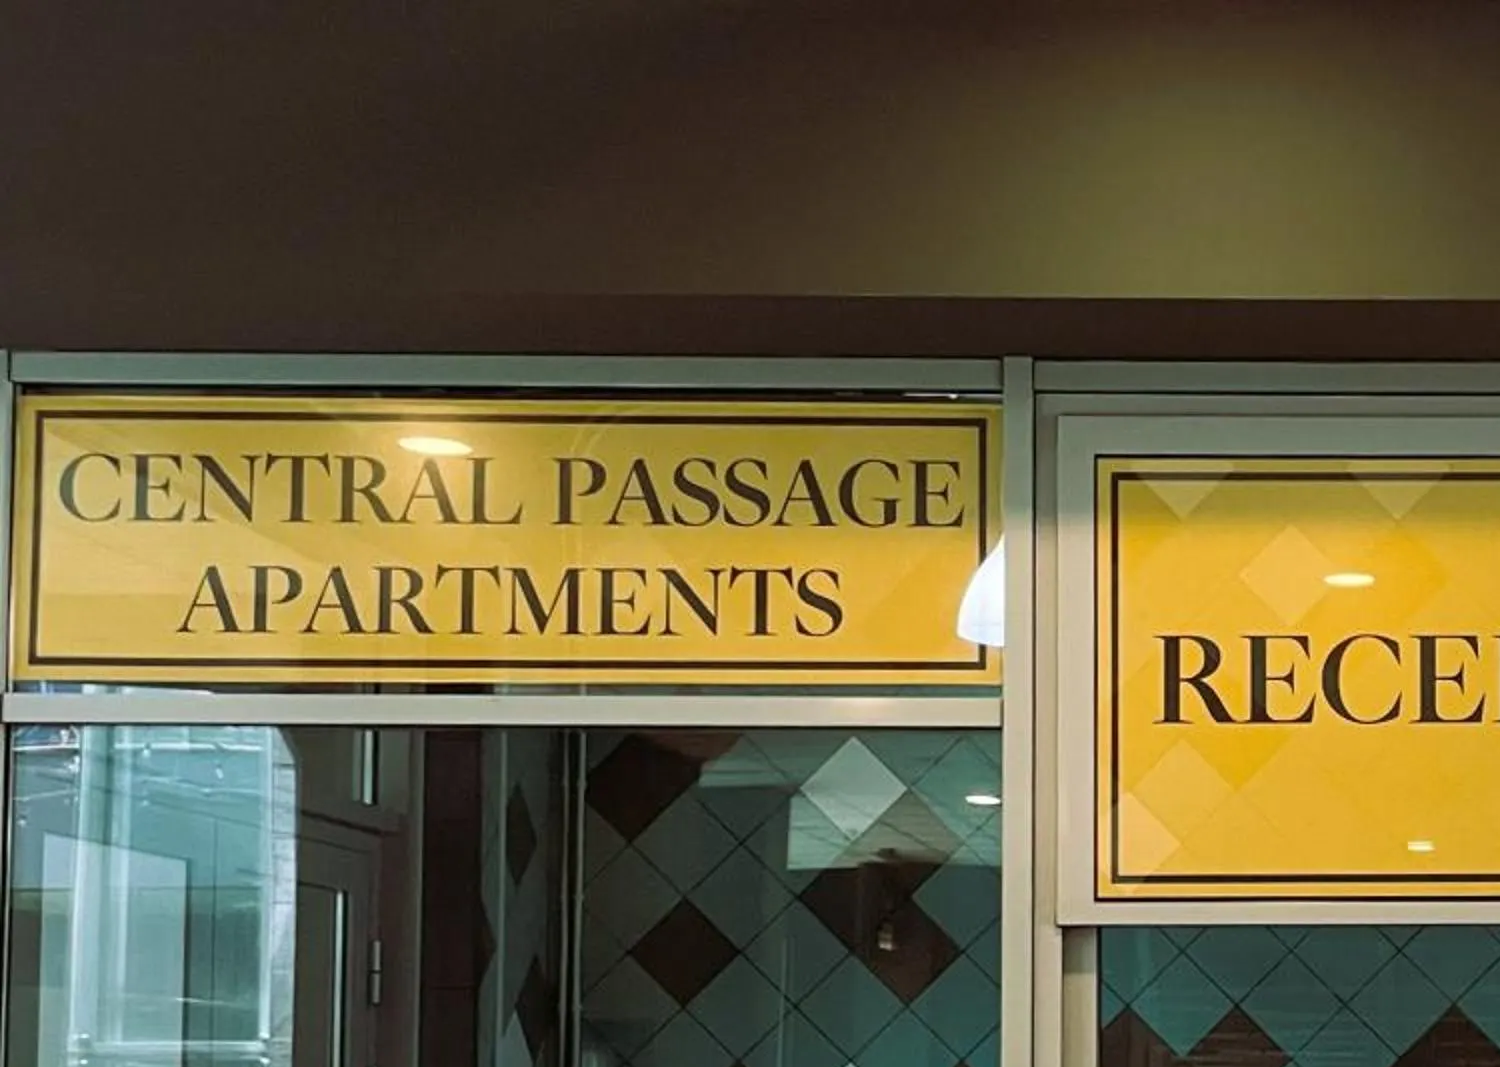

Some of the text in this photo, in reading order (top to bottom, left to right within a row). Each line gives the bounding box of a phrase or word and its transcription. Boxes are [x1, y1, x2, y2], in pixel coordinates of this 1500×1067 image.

[59, 453, 965, 528] CENTRAL PASSAGE
[177, 564, 845, 637] APARTMENTS
